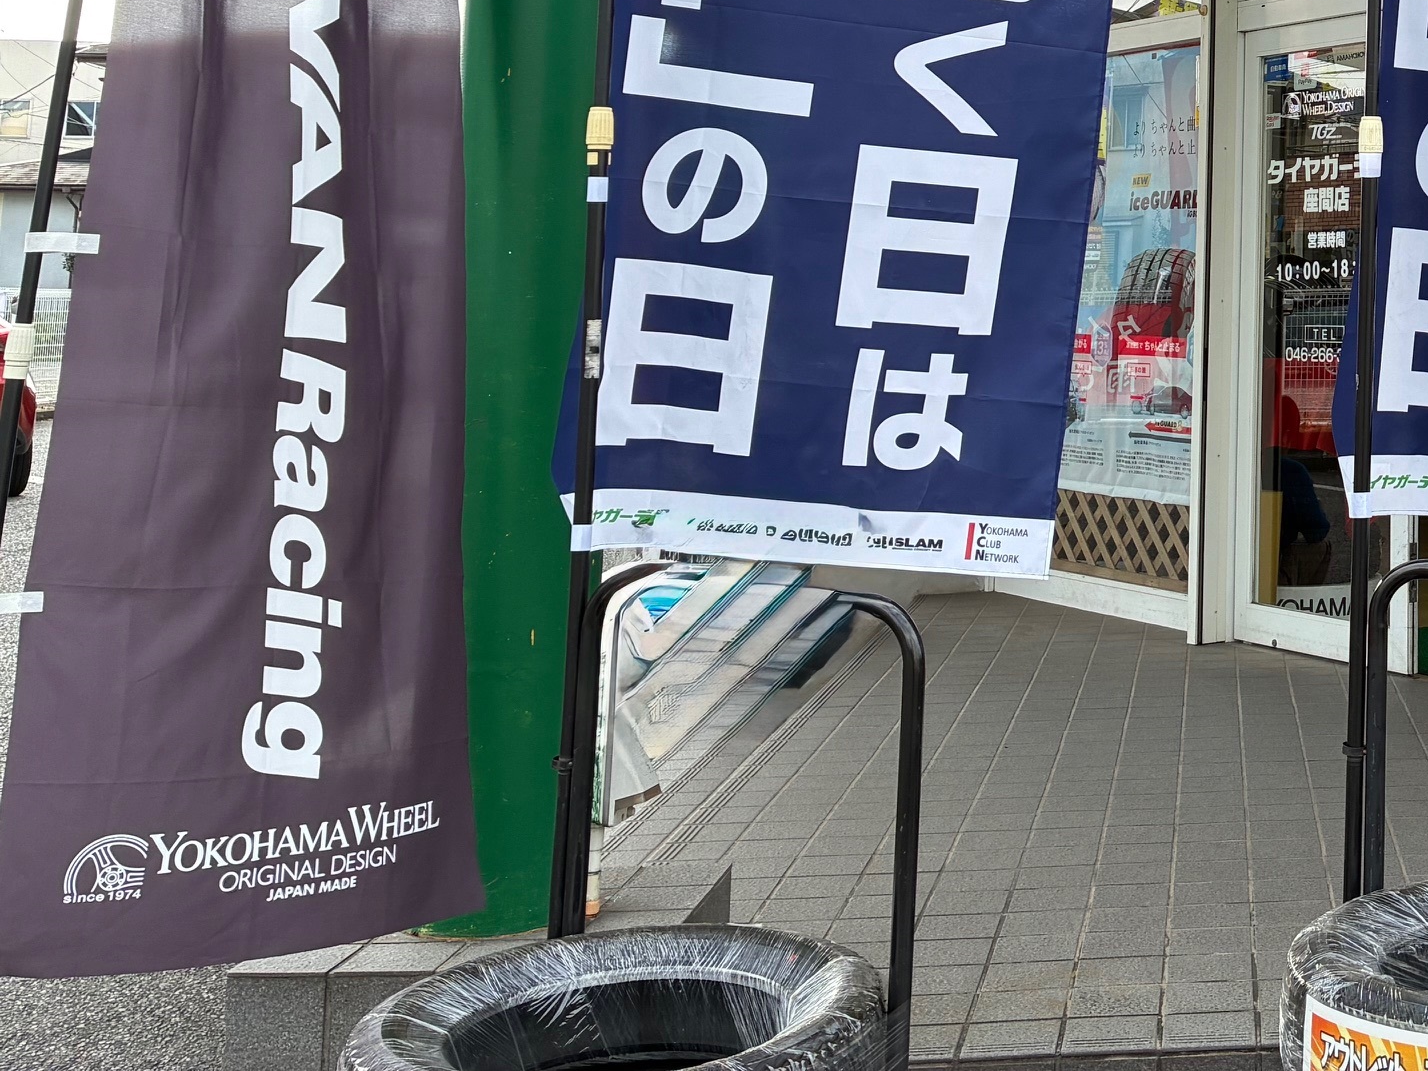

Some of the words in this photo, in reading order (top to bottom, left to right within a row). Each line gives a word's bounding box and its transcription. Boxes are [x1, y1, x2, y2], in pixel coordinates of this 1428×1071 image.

[1302, 89, 1340, 104] YOKOHAMA
[1302, 103, 1327, 116] WHEEL
[1327, 101, 1354, 113] DESIGN
[1303, 185, 1350, 213] 座間店
[1307, 230, 1346, 249] 営業時間
[1313, 328, 1337, 341] TEL
[977, 521, 1029, 538] YOKOHAMA
[977, 536, 1002, 550] CLUB
[976, 548, 1020, 564] NETWORK
[1275, 596, 1351, 617] OHAM
[149, 820, 349, 875] YOKOHAMA
[348, 800, 441, 842] WHEEL
[218, 859, 325, 893] ORIGINAL
[330, 844, 397, 874] DESIGN
[63, 892, 105, 904] since
[107, 888, 142, 902] 1974
[266, 882, 316, 902] JAPAN
[319, 875, 358, 894] MADE
